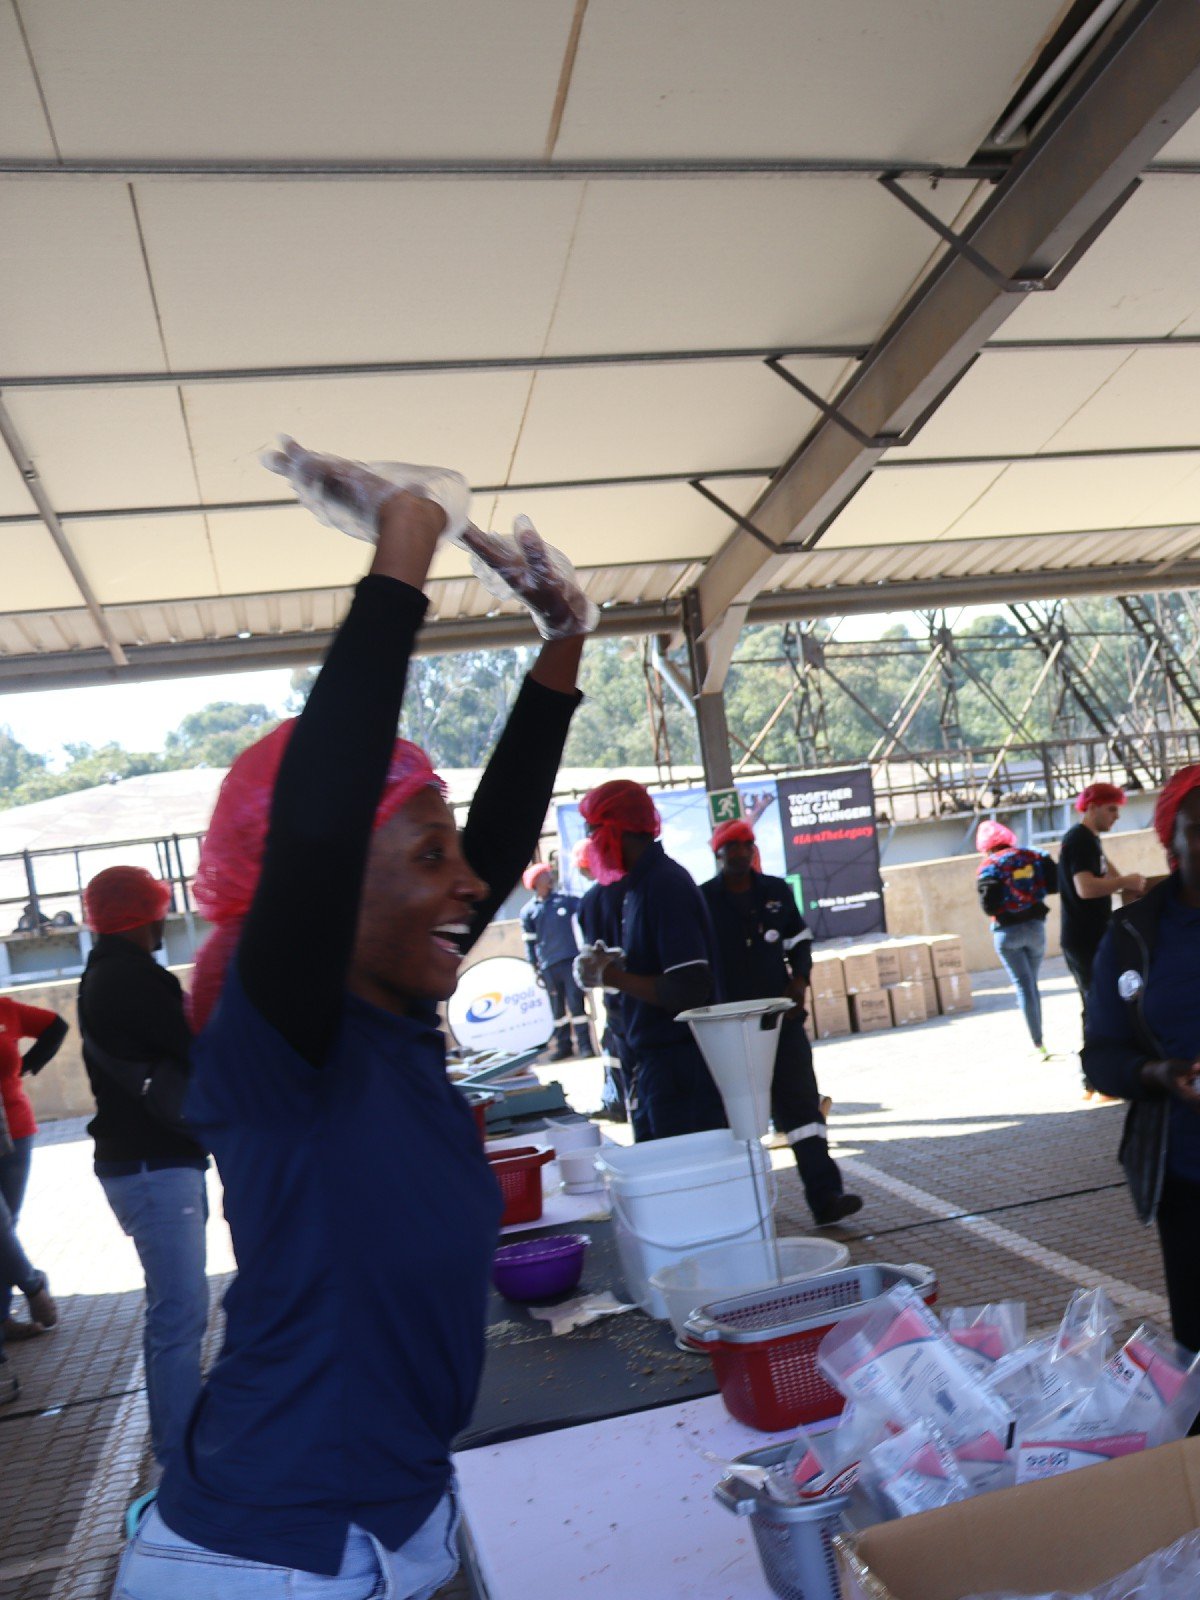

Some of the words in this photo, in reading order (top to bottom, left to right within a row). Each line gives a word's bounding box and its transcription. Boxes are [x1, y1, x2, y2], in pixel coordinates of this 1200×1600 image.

[788, 788, 853, 806] TOGETHER
[789, 803, 811, 816] WE
[811, 800, 840, 814] CAN
[790, 813, 818, 828] END
[817, 806, 872, 824] HUNGER!
[504, 986, 535, 1005] egoli
[520, 998, 542, 1014] gas
